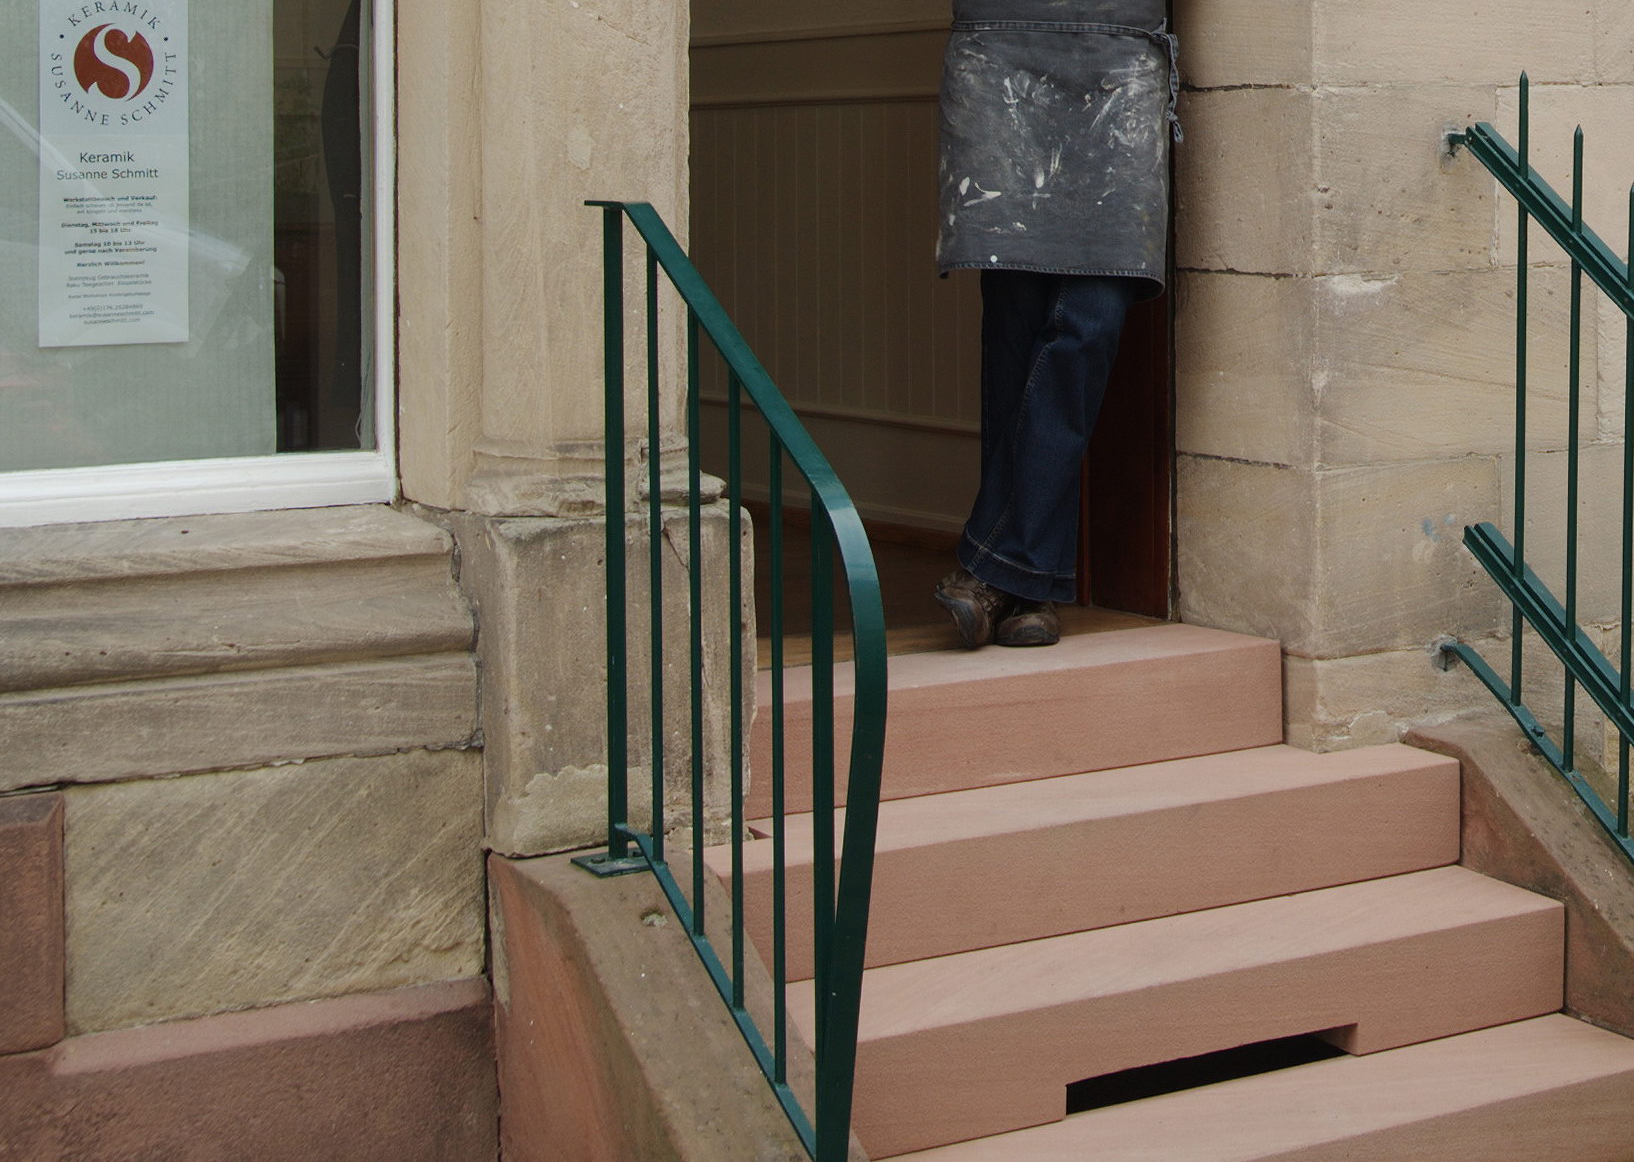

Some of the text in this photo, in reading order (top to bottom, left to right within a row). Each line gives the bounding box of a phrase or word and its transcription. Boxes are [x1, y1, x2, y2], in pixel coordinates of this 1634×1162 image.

[67, 0, 161, 29] KERAMIK
[51, 52, 176, 126] SUSANNE SCHMITT
[80, 151, 135, 163] Keramik
[57, 168, 159, 180] Susanne Schmitt
